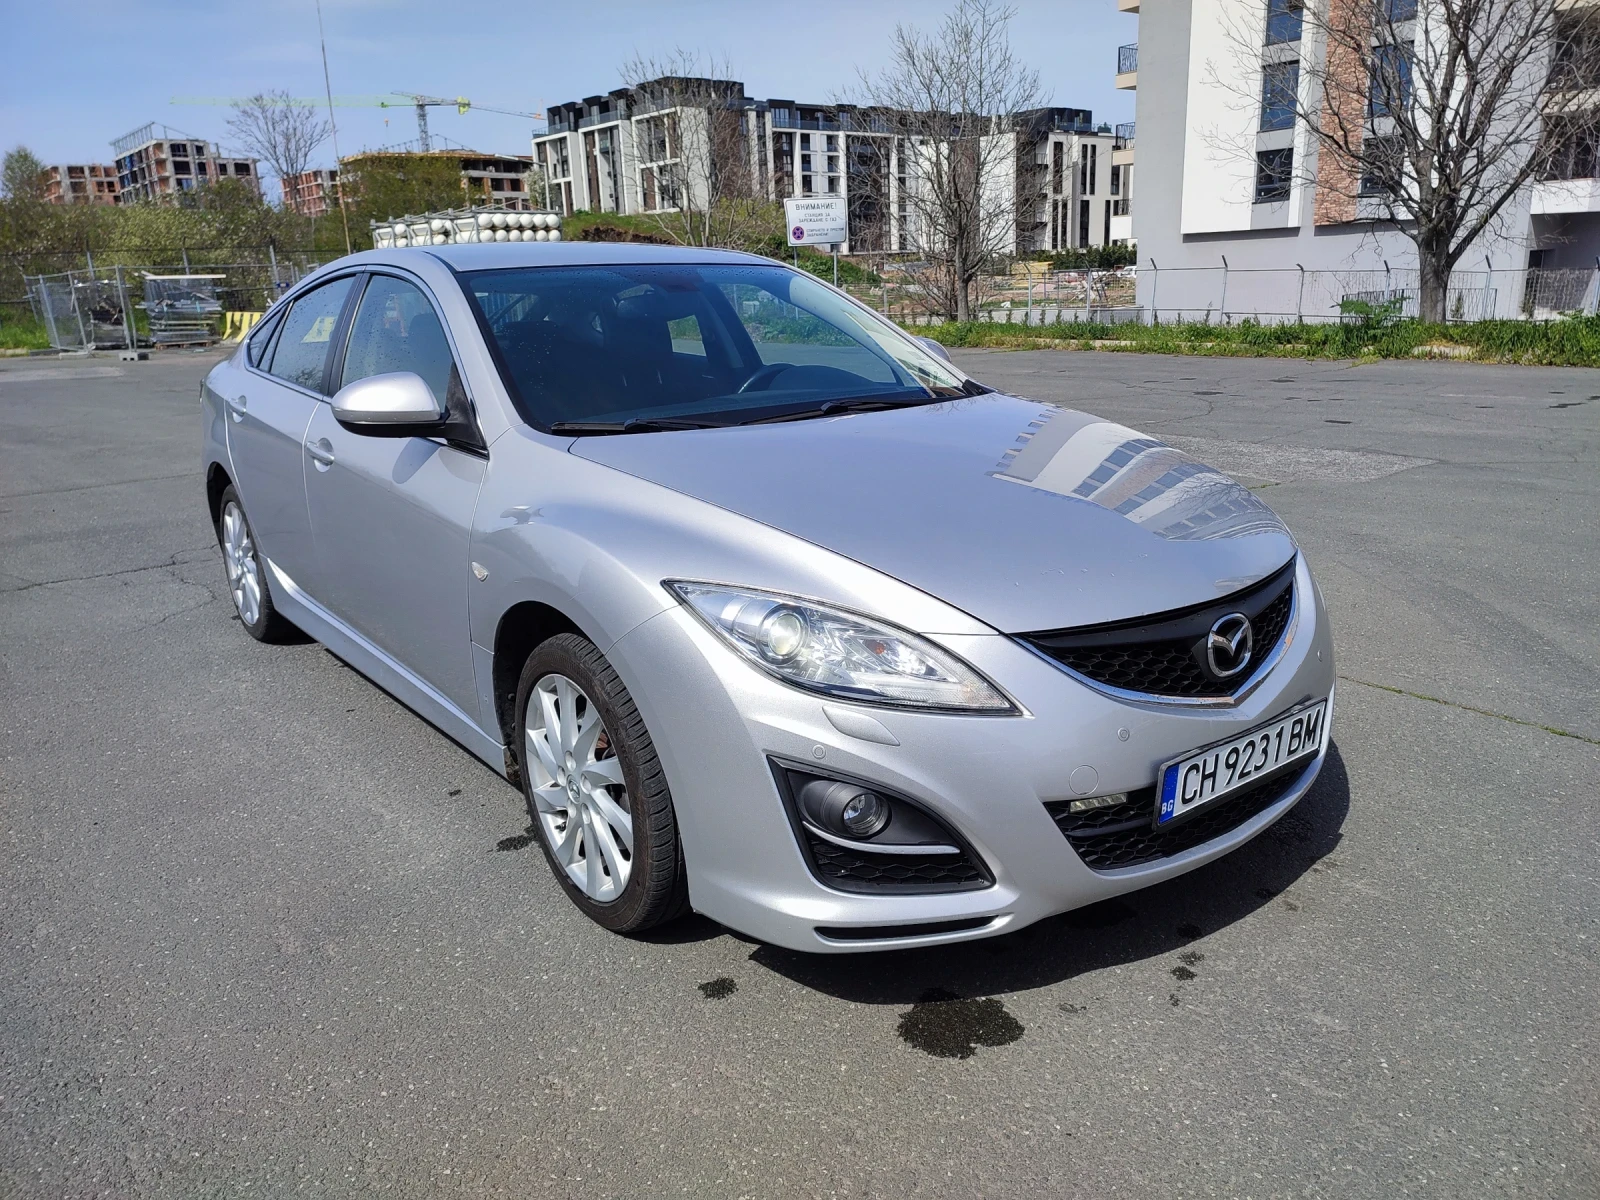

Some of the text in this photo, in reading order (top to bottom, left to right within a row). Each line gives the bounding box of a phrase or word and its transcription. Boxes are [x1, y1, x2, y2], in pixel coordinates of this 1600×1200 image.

[795, 202, 836, 210] ВНИМАНИЕ!
[1180, 708, 1321, 805] CH 9231 BM
[1161, 799, 1174, 815] BG
